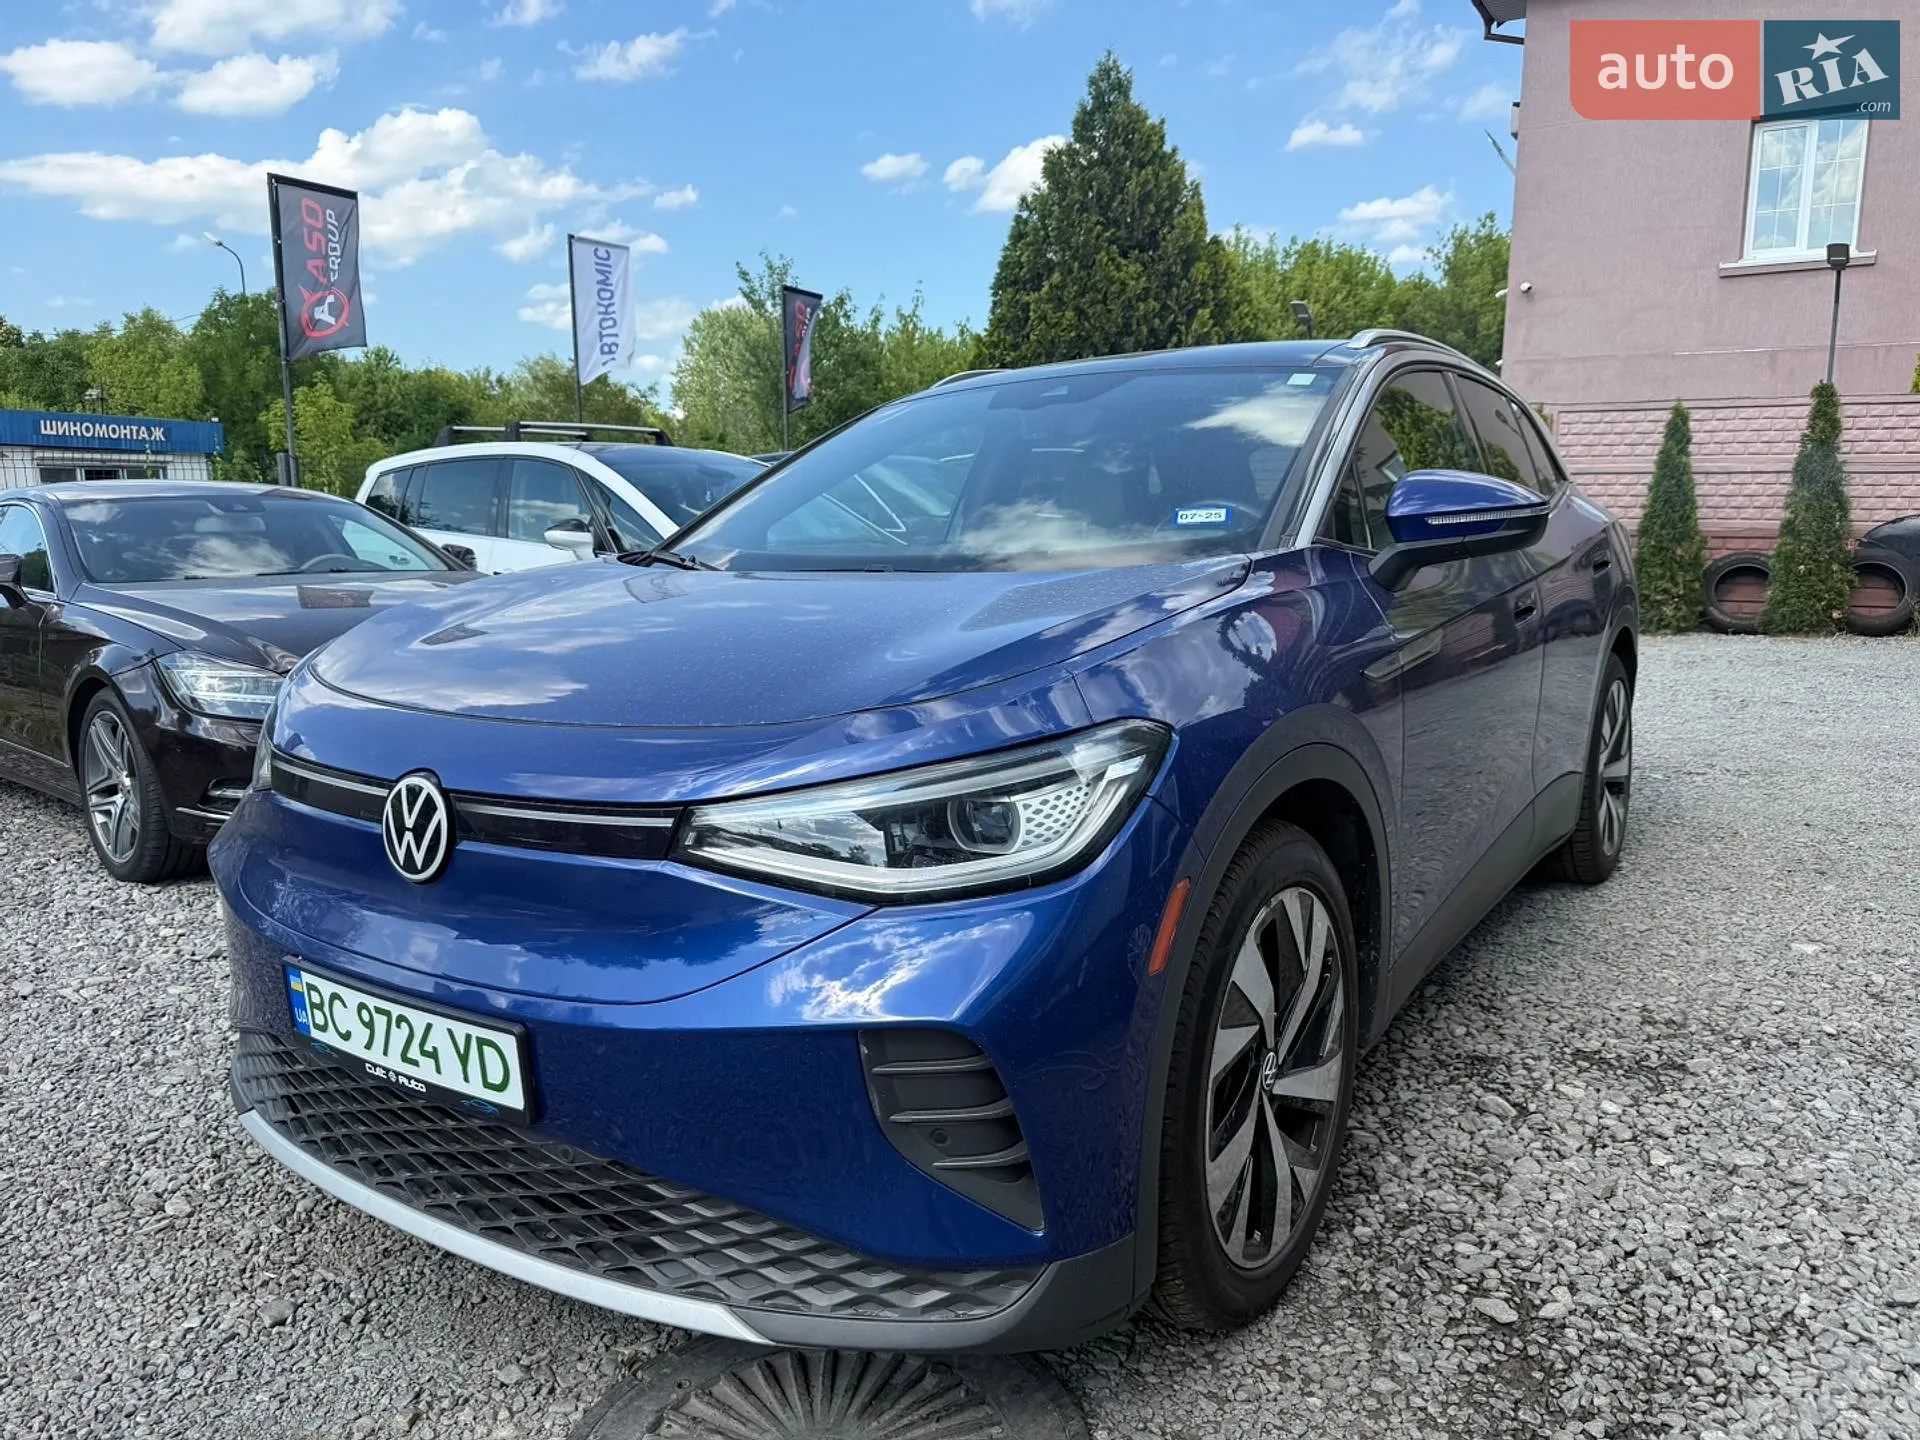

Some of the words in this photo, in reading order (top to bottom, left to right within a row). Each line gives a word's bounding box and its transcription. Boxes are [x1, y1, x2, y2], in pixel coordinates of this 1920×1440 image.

[301, 197, 328, 285] ASO
[40, 419, 166, 441] ШИНОМОНТАЖ
[1179, 511, 1223, 521] 07-25
[294, 1006, 309, 1025] UA
[305, 981, 352, 1042] BC
[356, 1001, 442, 1075] 9724
[446, 1027, 511, 1093] YD
